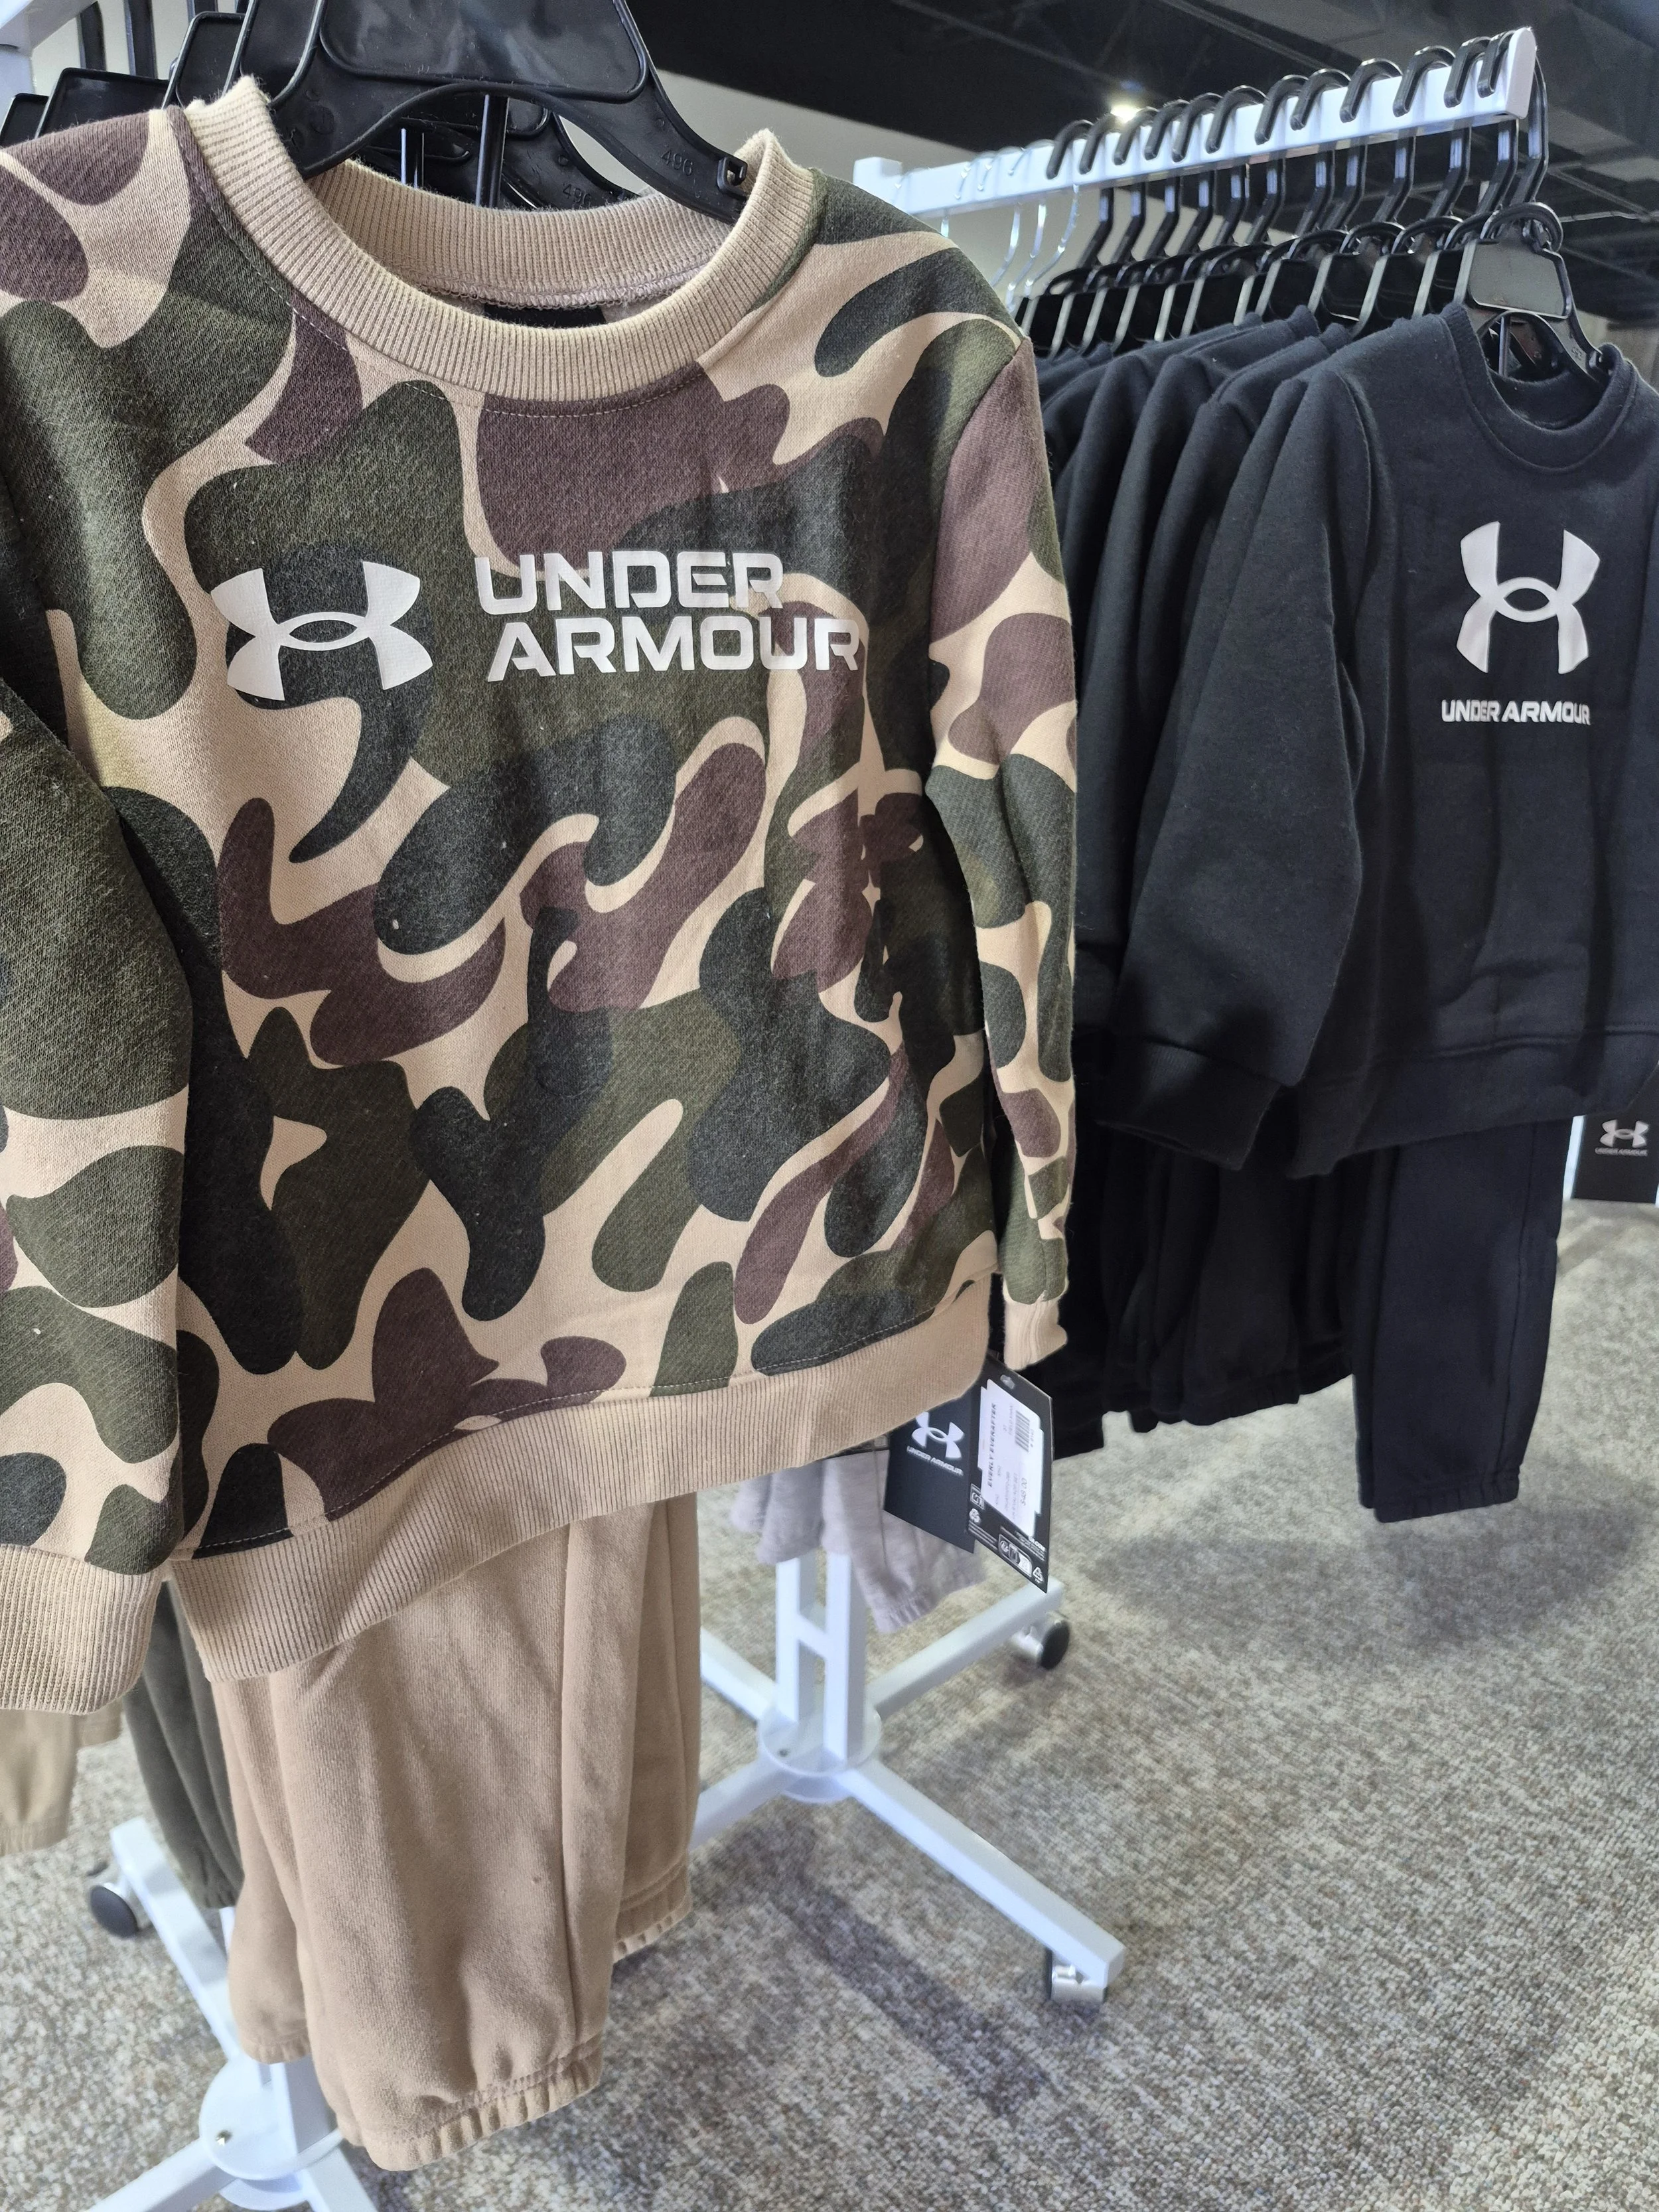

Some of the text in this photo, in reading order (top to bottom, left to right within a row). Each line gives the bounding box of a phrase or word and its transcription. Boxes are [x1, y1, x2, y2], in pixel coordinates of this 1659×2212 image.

[659, 150, 693, 176] 496
[474, 550, 784, 615] UNDER
[488, 616, 859, 682] ARMOUR
[1441, 699, 1591, 725] UNDER ARMOUR
